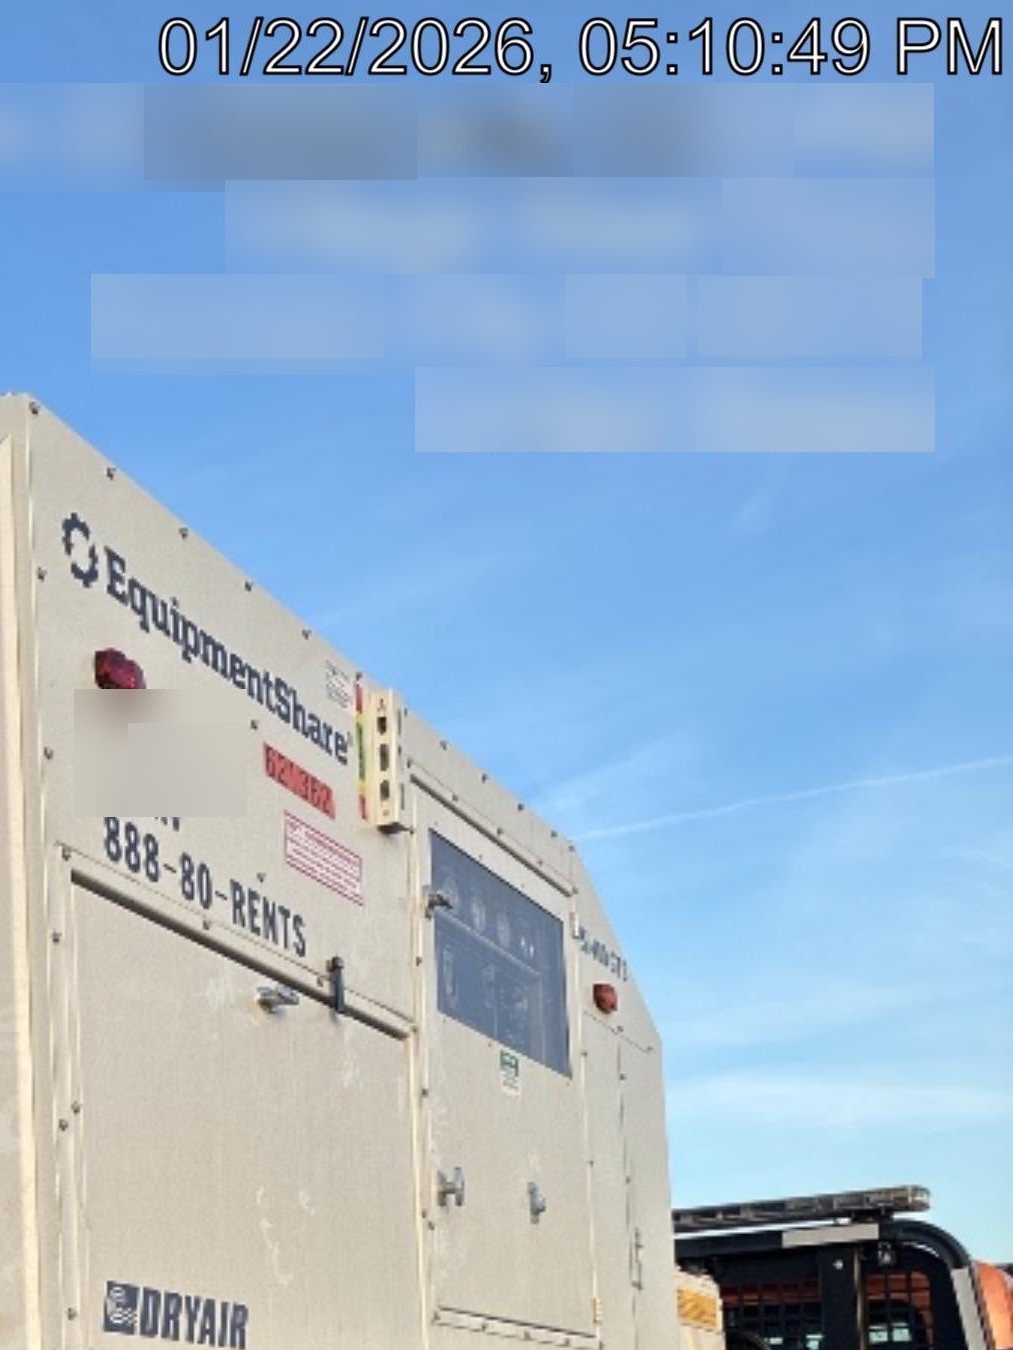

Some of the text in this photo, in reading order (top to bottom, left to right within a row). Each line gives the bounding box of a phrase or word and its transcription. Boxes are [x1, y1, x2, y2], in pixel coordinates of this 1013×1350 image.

[104, 545, 348, 766] EquipmentShare
[104, 816, 306, 957] 888-80-RENTS
[140, 1287, 249, 1350] DRYAIR
